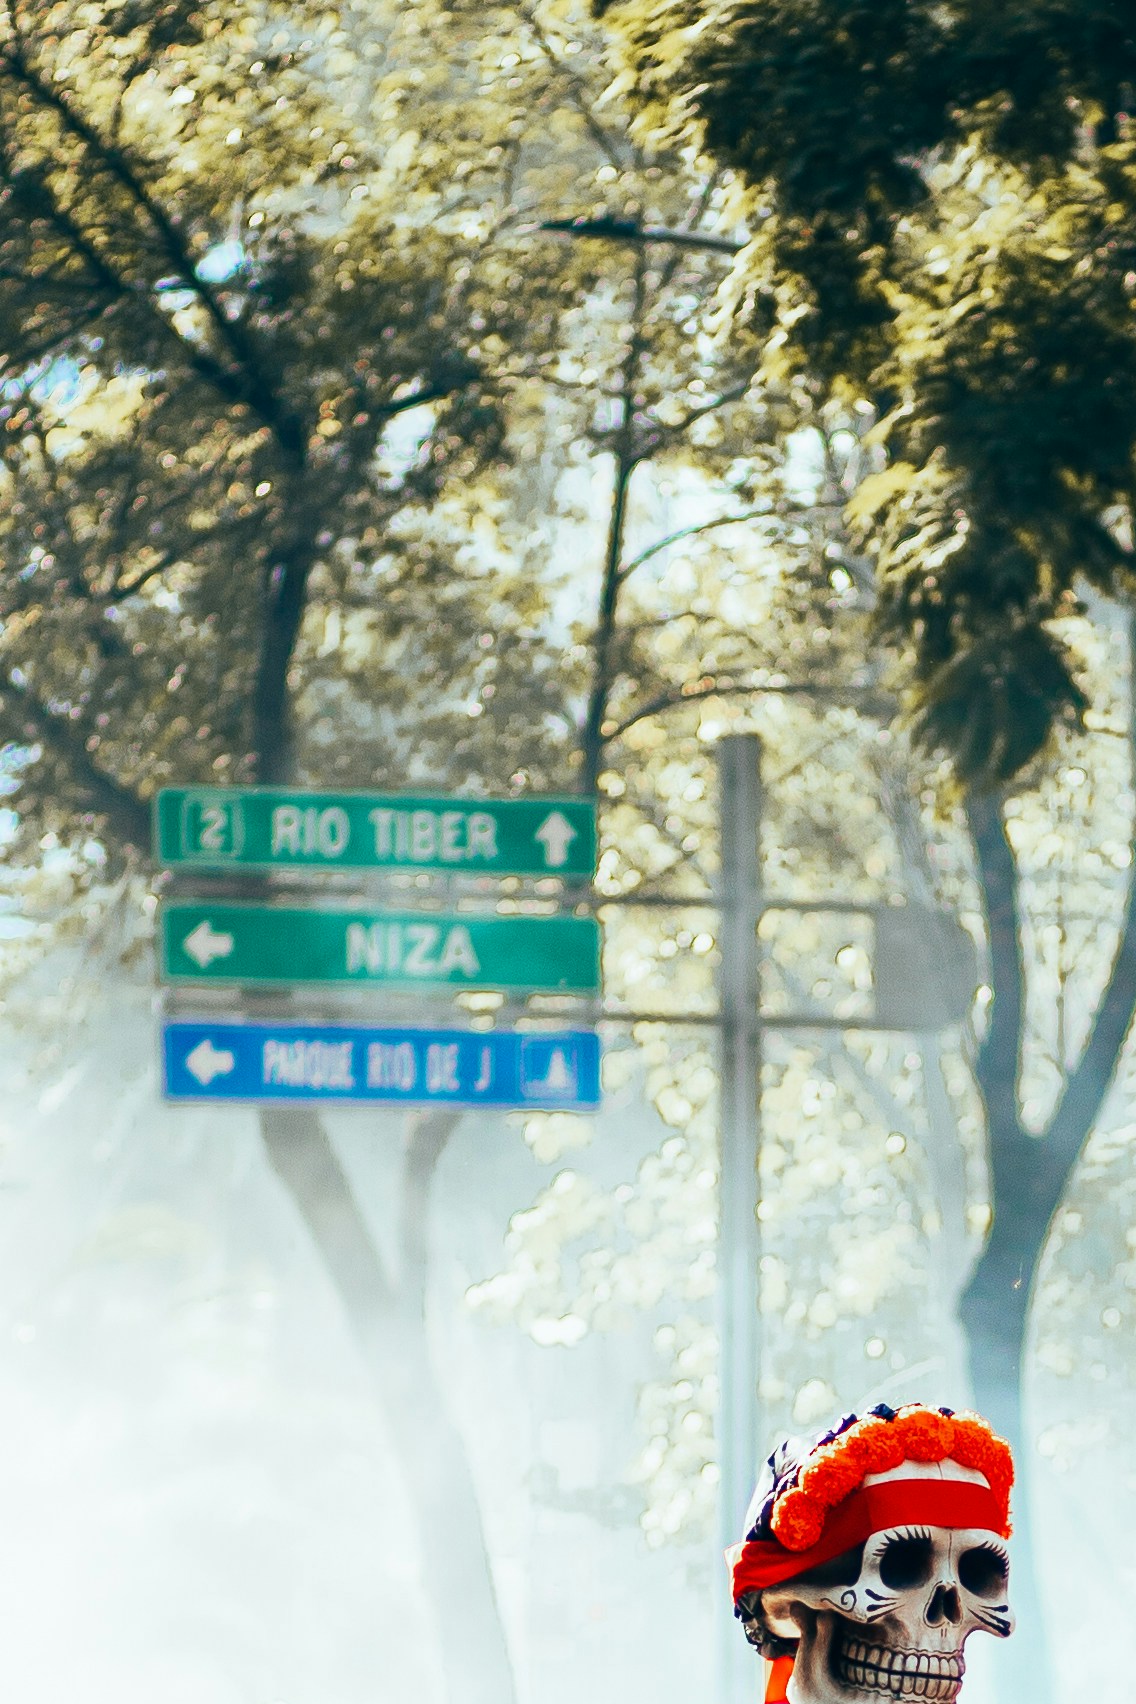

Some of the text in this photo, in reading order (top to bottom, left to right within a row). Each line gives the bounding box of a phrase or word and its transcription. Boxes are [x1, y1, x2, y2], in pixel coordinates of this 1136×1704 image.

[271, 805, 350, 858] RIO
[368, 809, 498, 861] TIBER
[345, 921, 480, 977] NIZA
